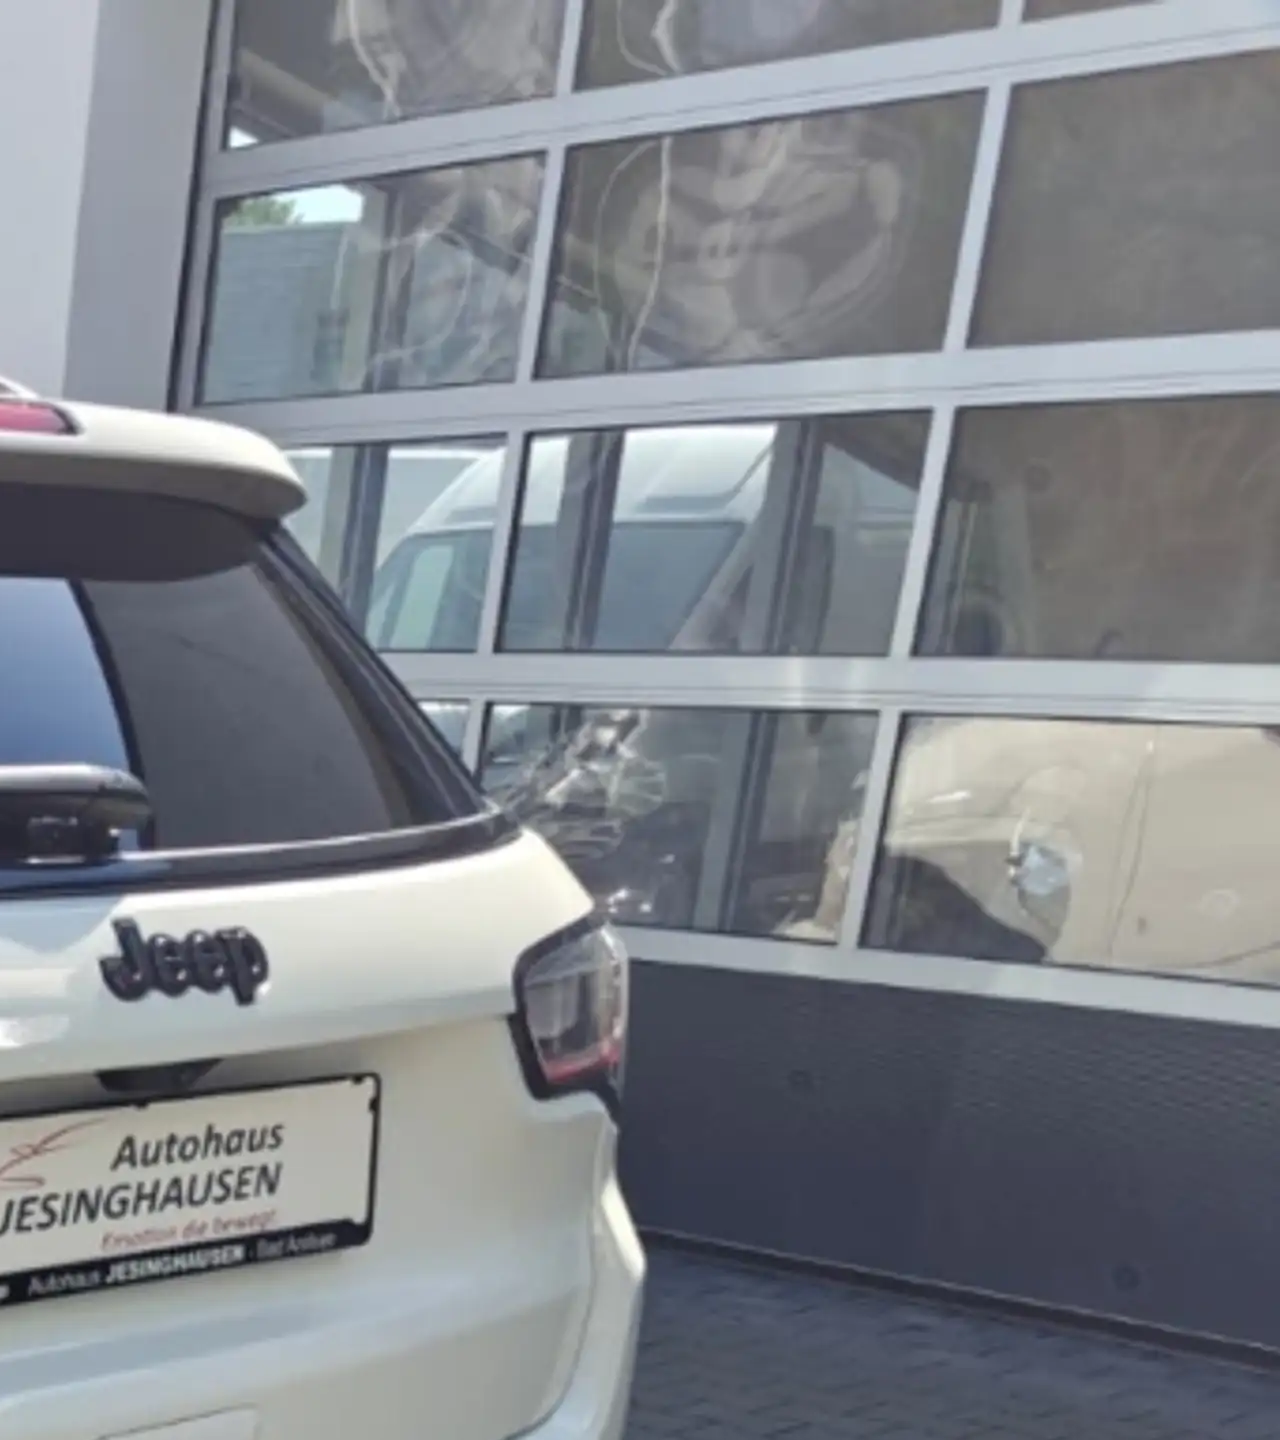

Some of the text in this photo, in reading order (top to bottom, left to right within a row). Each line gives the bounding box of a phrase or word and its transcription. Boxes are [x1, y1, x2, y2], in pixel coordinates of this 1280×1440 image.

[99, 916, 269, 1006] Jeep
[110, 1124, 285, 1170] Autohaus
[105, 1244, 246, 1283] JESINGHAUSEN
